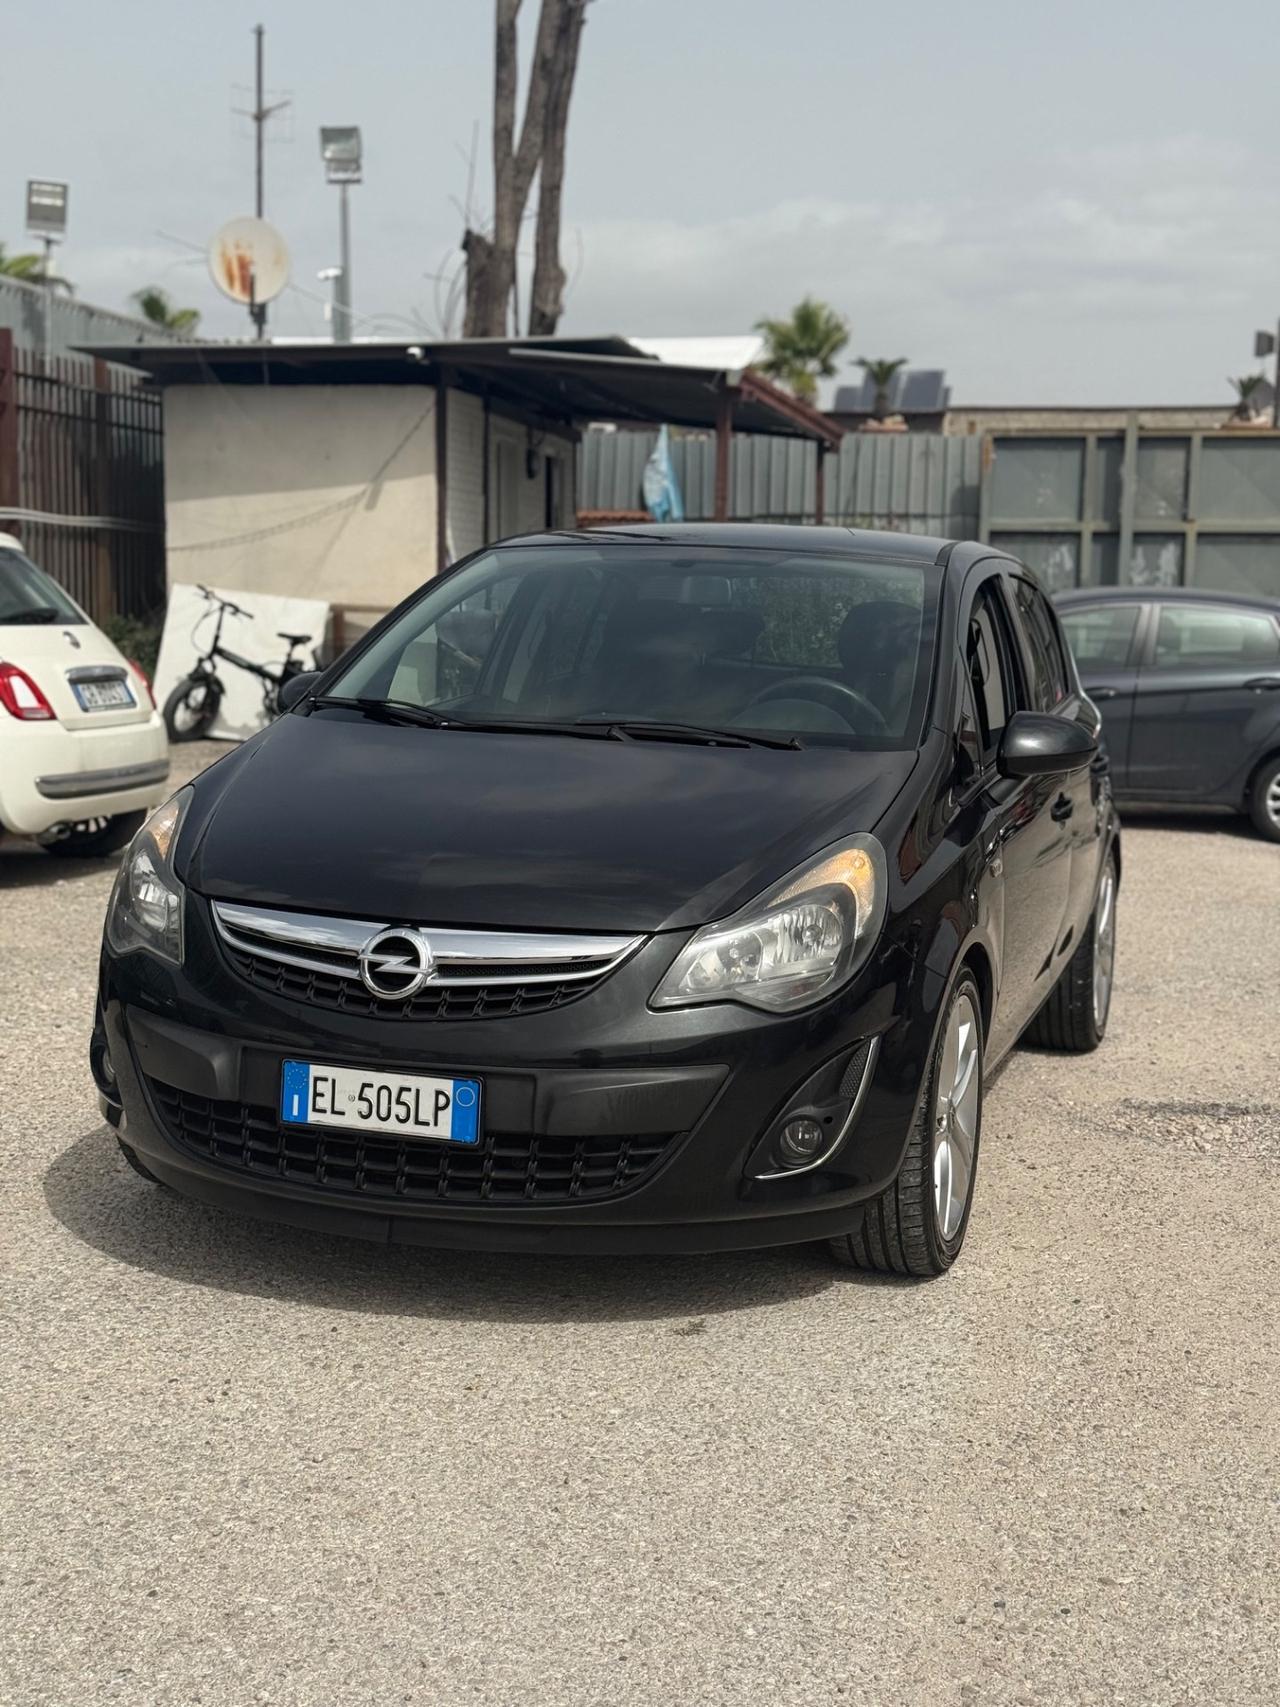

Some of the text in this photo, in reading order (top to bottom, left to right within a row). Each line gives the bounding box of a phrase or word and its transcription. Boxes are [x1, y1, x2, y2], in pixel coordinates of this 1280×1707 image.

[292, 1094, 299, 1116] I
[312, 1076, 451, 1127] EL 505LP
